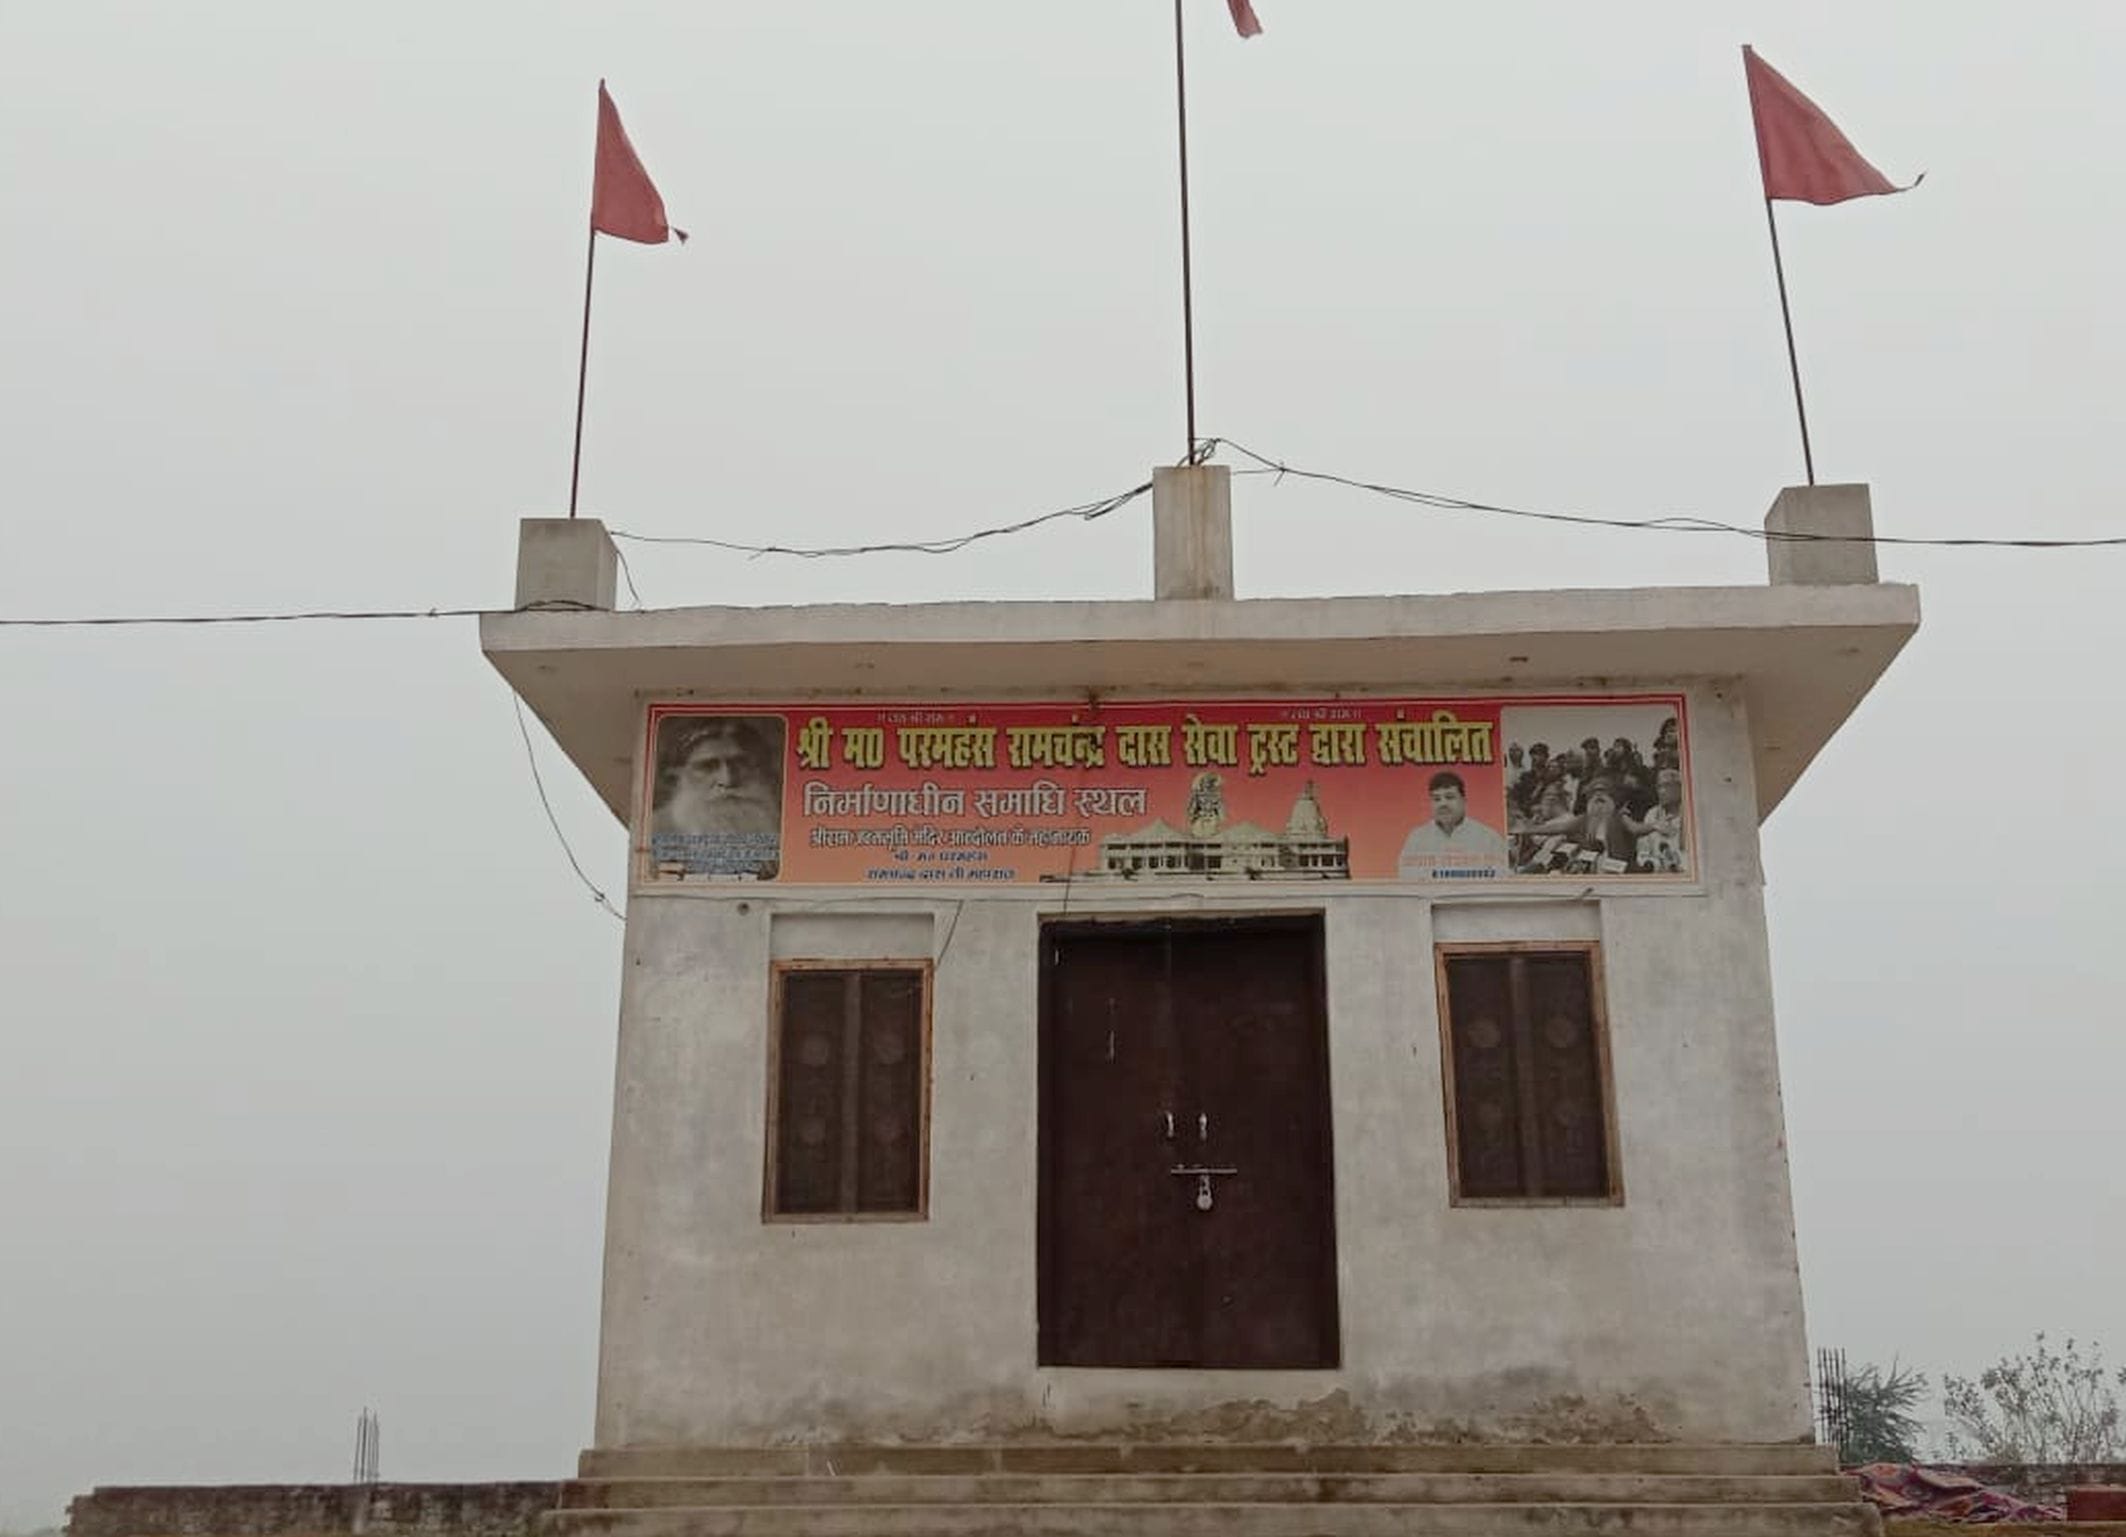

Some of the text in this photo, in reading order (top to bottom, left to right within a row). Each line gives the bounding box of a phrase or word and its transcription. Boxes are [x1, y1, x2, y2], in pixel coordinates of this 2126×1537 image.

[797, 716, 832, 769] श्री
[897, 713, 997, 769] परमहंस
[1115, 725, 1171, 766] दास
[1181, 713, 1238, 766] सेवा
[1247, 723, 1299, 777] ट्रस्ट
[1309, 722, 1367, 766] द्वारा
[1375, 709, 1494, 765] संचालित
[803, 779, 1147, 818] निर्माणाधीन समाधि स्थल
